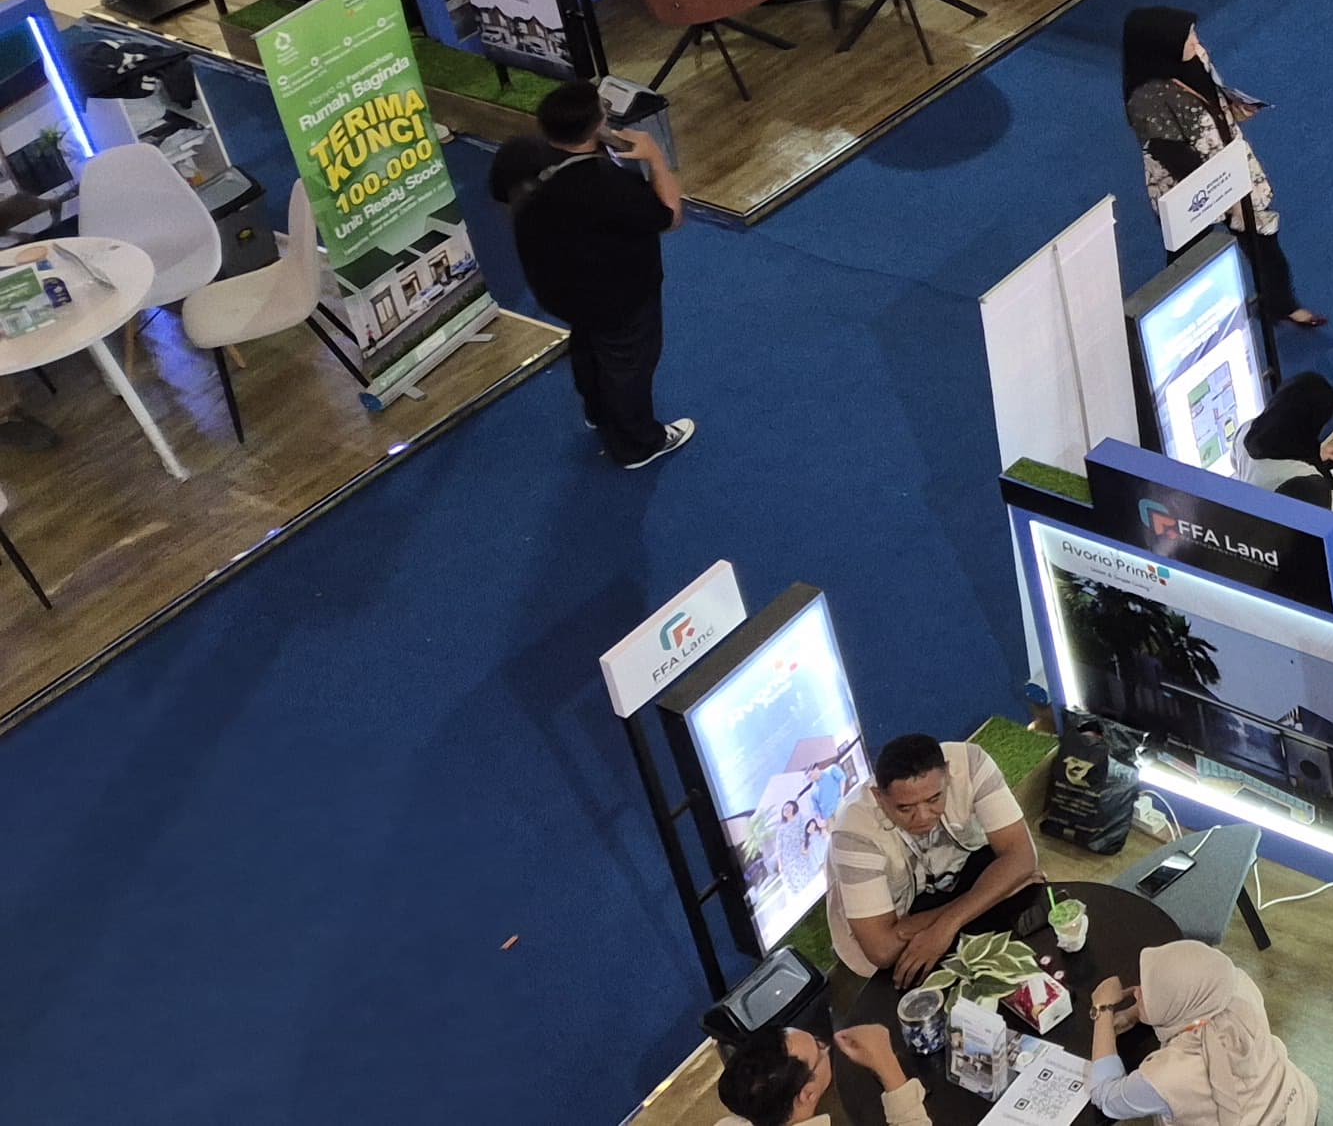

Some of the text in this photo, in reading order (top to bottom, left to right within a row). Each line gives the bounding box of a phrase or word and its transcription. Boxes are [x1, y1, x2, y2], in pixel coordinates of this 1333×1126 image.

[299, 91, 351, 132] Rumah
[352, 56, 410, 99] Baginda
[309, 89, 426, 169] TERIMA
[325, 114, 425, 193] KUNCI
[336, 138, 434, 215] 100.000
[335, 213, 364, 239] Unit
[364, 184, 405, 221] Ready
[405, 159, 445, 193] Stock
[1062, 540, 1159, 584] Avoria Prime
[1178, 519, 1220, 548] FFA
[1224, 535, 1279, 566] Land
[652, 625, 715, 682] FFA Land
